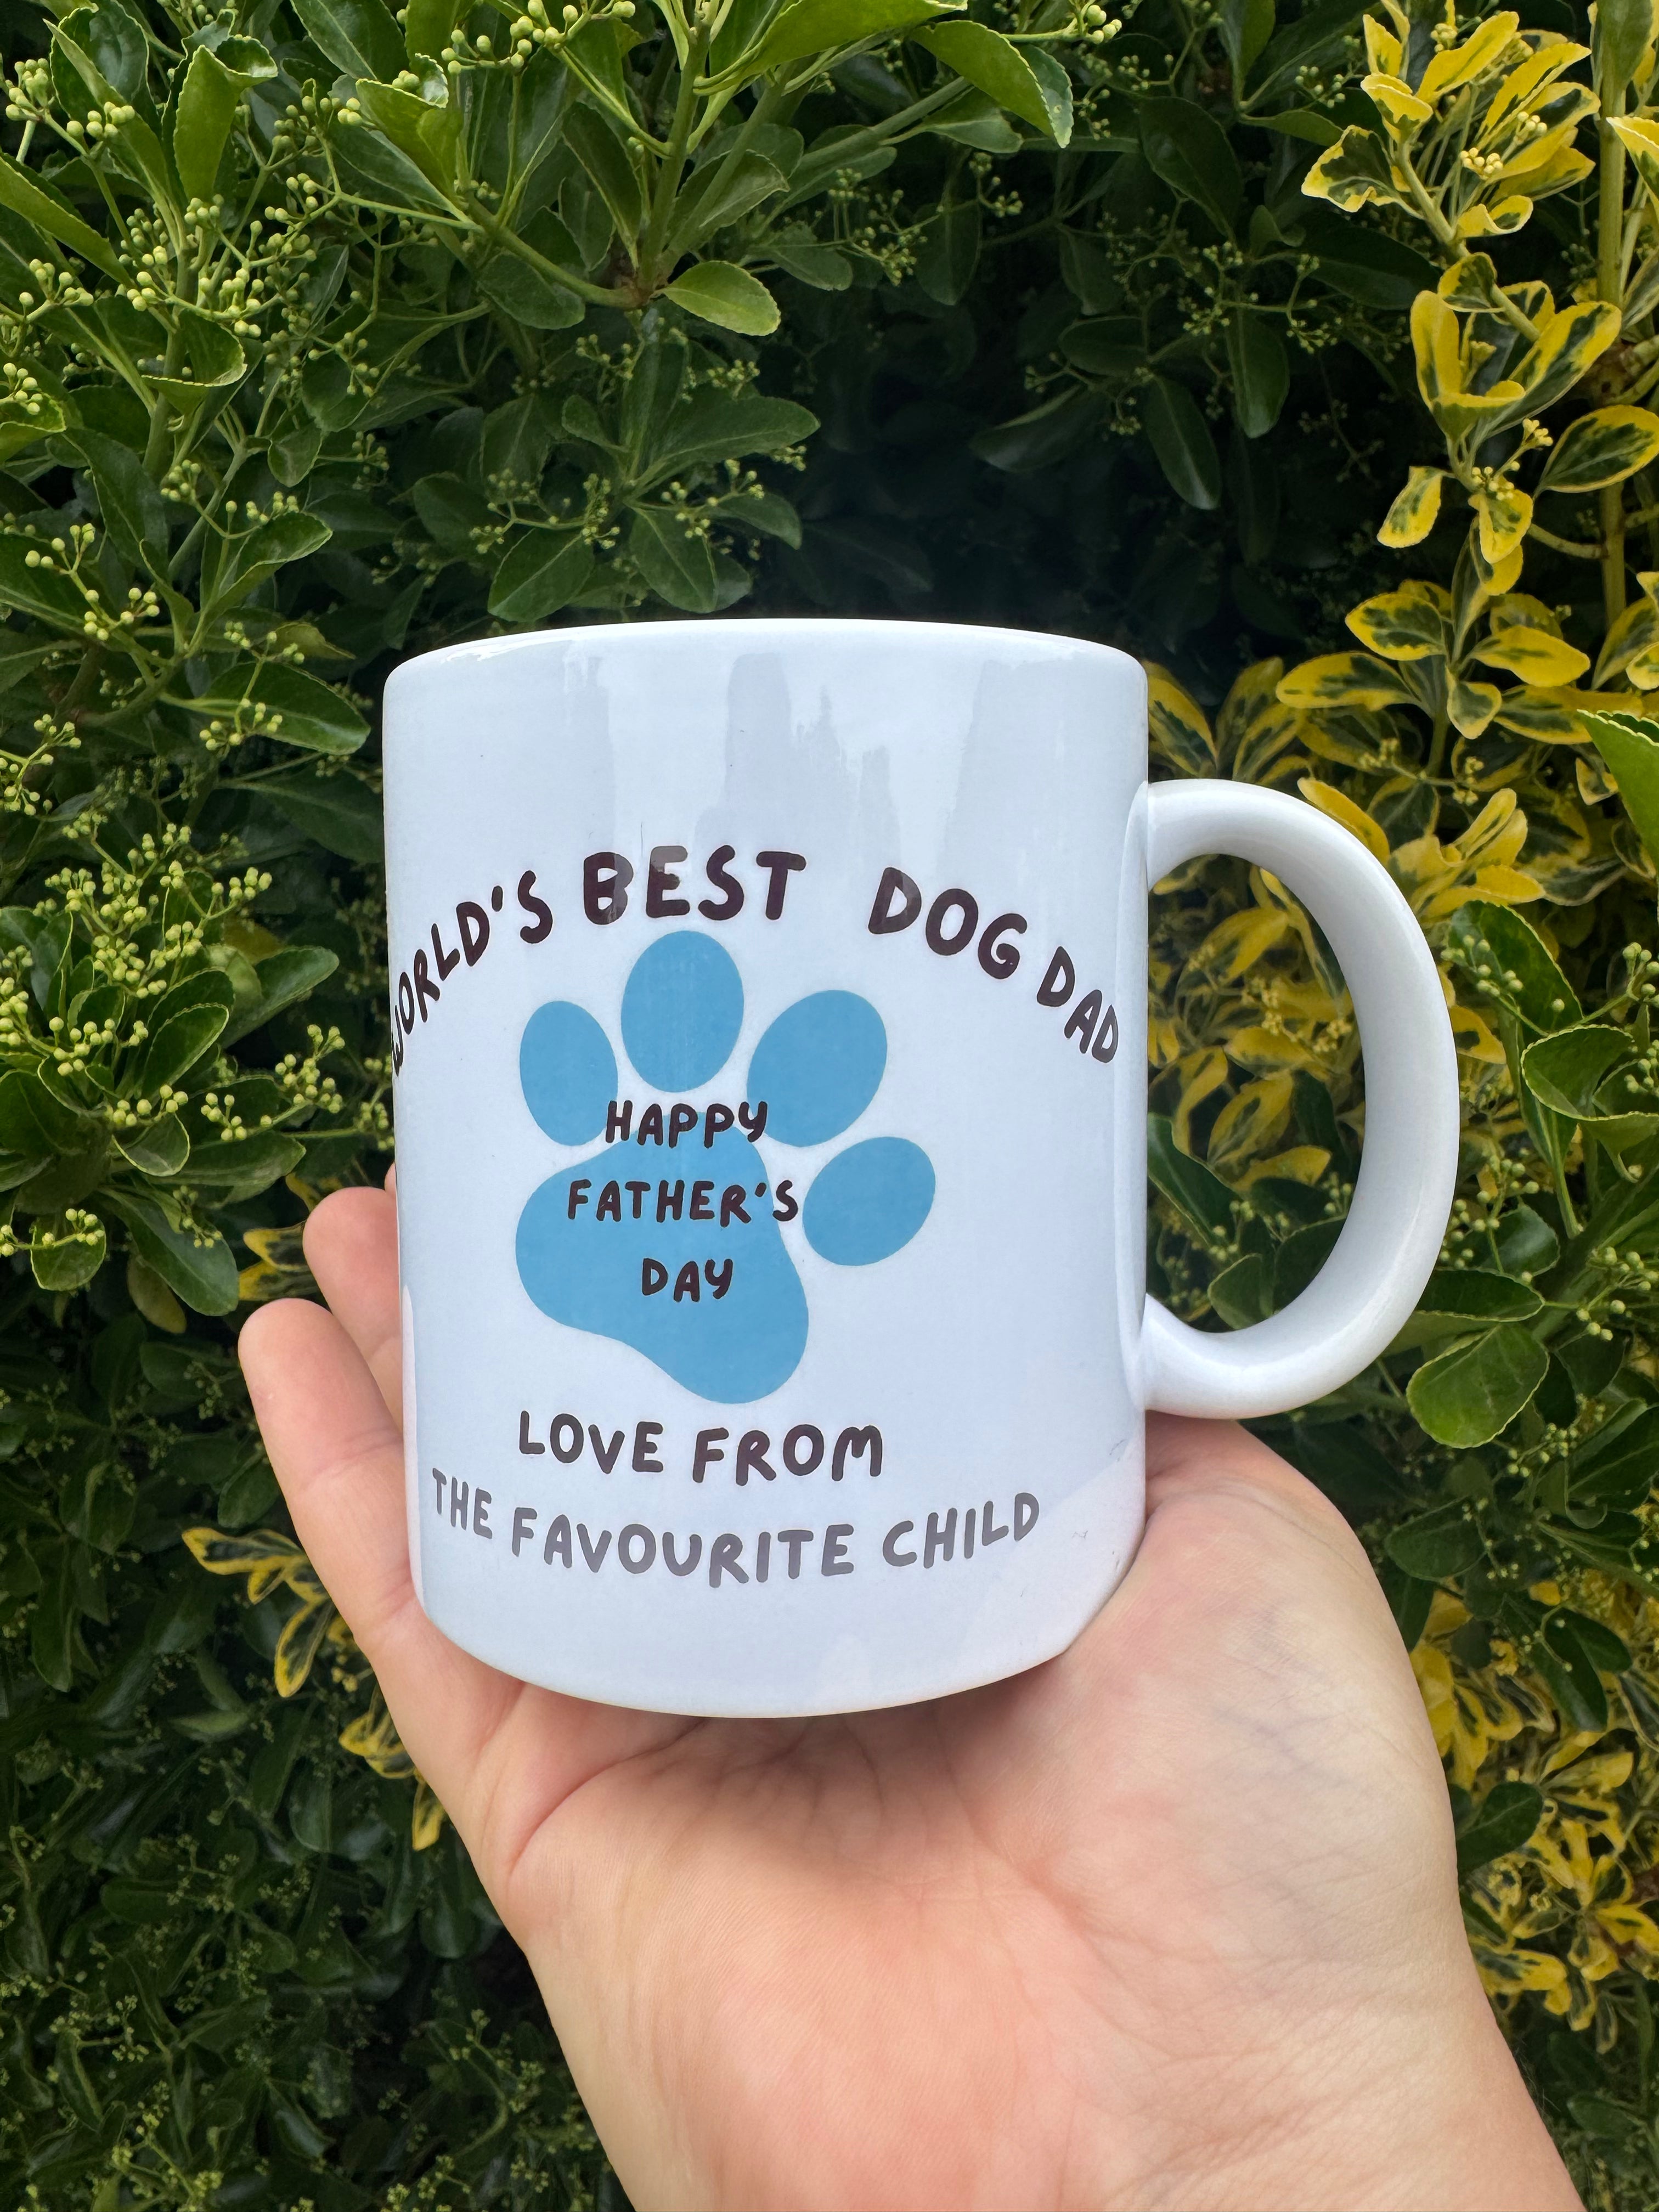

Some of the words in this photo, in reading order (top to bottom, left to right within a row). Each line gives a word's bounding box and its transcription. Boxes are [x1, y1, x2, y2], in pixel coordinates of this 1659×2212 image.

[391, 870, 553, 1077] WORLD'S
[583, 845, 807, 926] BEST
[867, 867, 1028, 980] DOG
[1036, 946, 1119, 1064] DAD
[605, 1099, 769, 1148] HAPPY
[568, 1179, 799, 1228] FATHER'S
[641, 1258, 733, 1302] DAY
[519, 1410, 664, 1475] LOVE
[692, 1424, 883, 1487] FROM
[432, 1468, 493, 1539] THE
[512, 1507, 854, 1588] FAVOURITE
[882, 1492, 1040, 1569] CHILD
